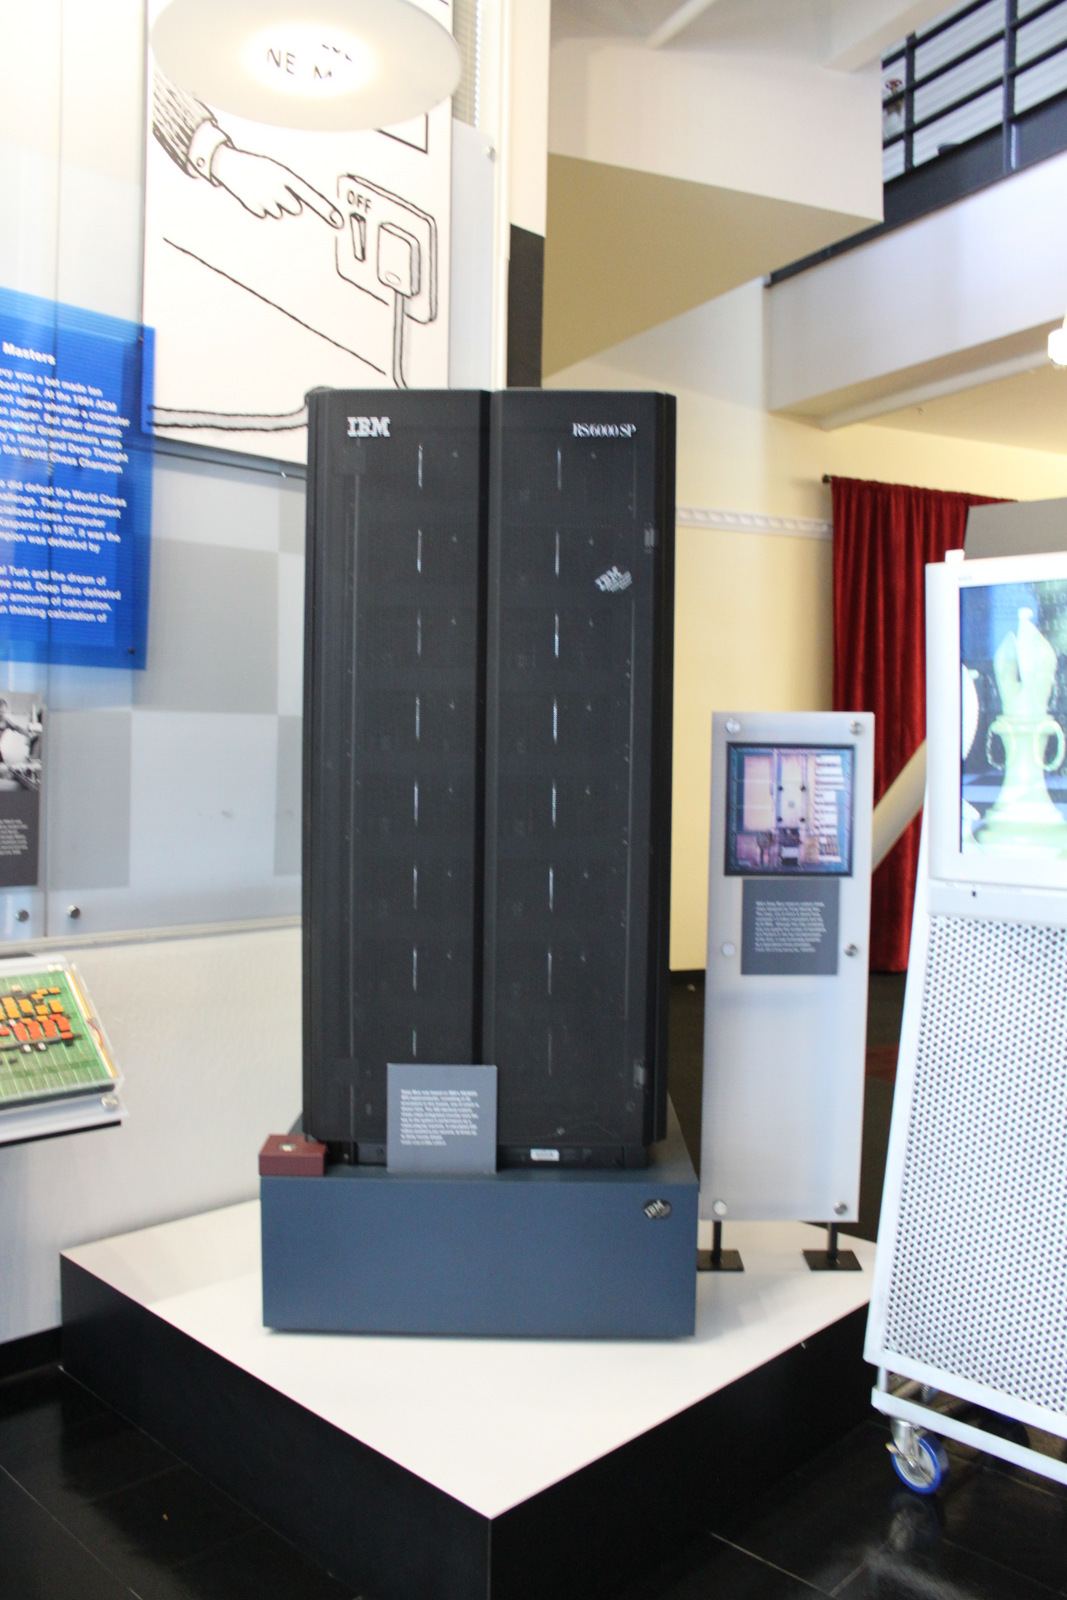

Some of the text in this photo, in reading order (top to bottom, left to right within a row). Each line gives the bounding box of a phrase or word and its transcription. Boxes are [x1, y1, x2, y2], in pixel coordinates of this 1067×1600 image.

[347, 190, 371, 214] OFF
[2, 341, 56, 366] Masters
[347, 416, 391, 437] IBM
